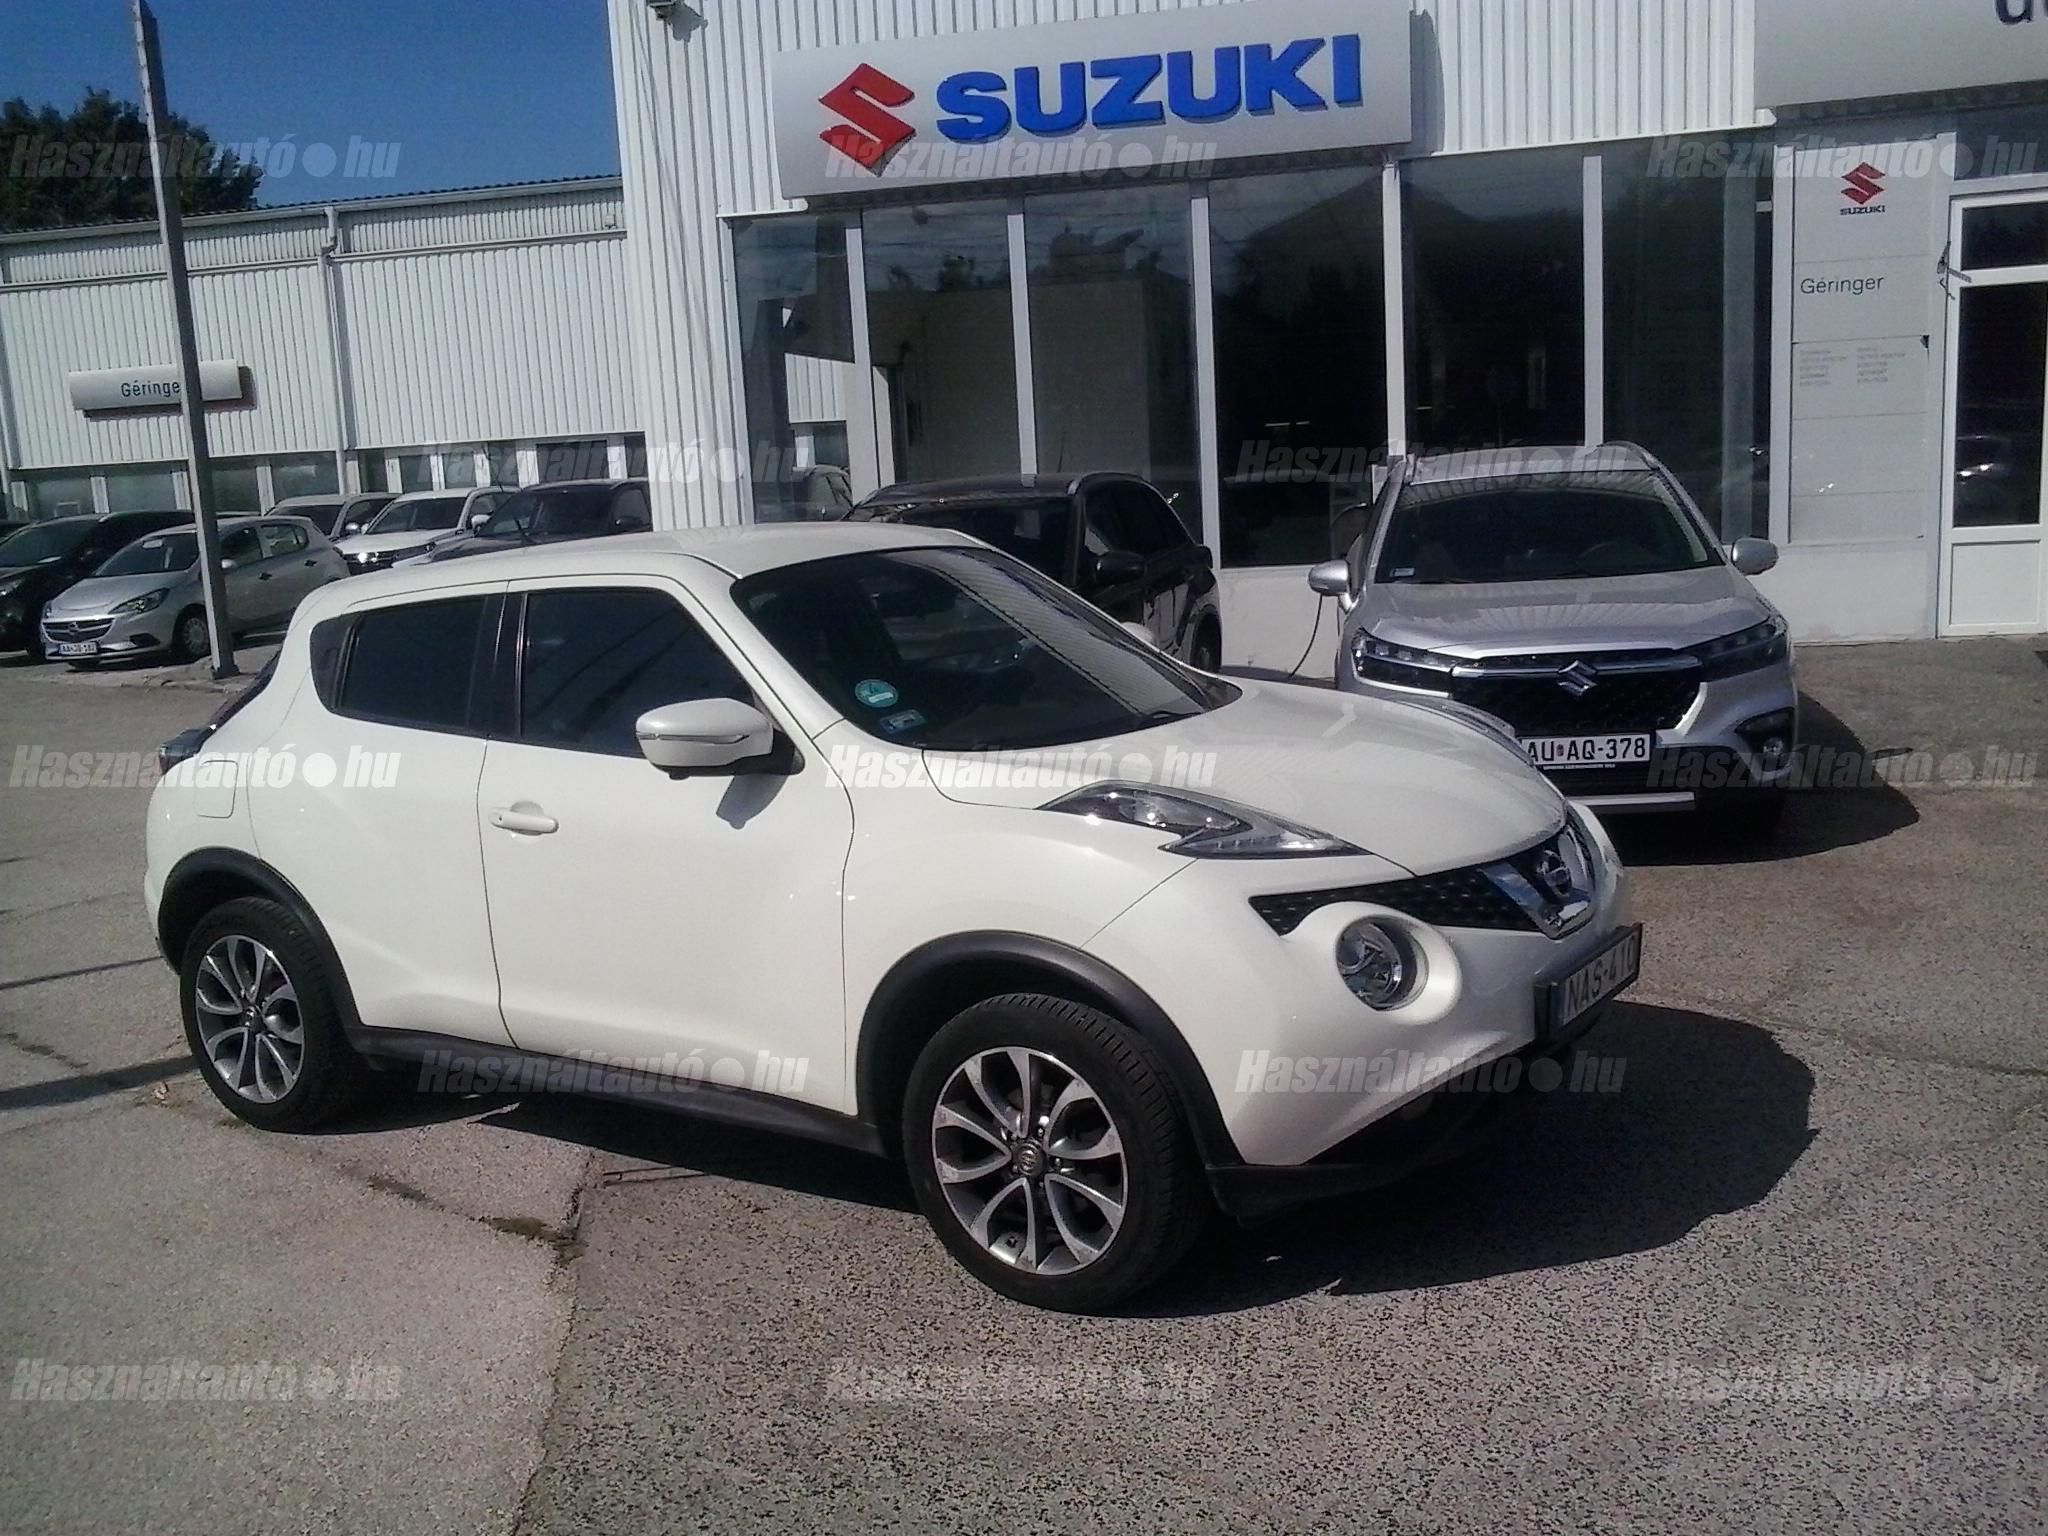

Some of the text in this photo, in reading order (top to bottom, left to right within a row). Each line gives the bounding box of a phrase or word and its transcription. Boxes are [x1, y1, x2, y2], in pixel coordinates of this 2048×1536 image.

[936, 34, 1362, 143] SUZUKI
[1839, 204, 1886, 215] SUZUKI
[1800, 276, 1884, 296] Géringer
[121, 379, 182, 397] Géringe
